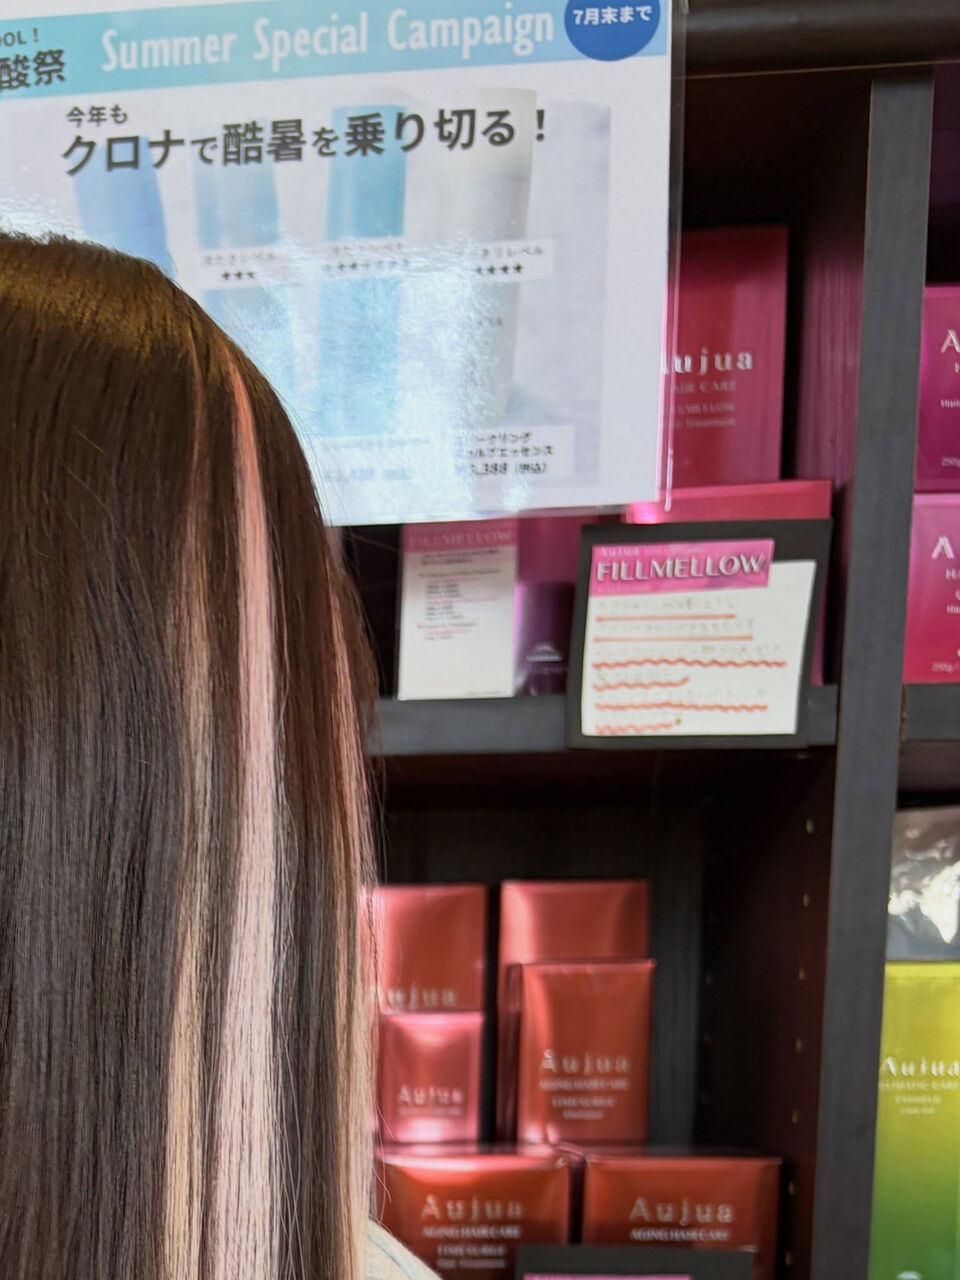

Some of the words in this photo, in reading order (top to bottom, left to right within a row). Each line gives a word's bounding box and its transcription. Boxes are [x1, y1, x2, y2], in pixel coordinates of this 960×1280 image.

[572, 5, 653, 27] 7月末まで
[101, 29, 237, 72] Summer
[253, 12, 368, 73] Special
[387, 2, 555, 59] Campaign
[66, 104, 129, 127] 今年も
[663, 347, 753, 376] ujua
[596, 554, 767, 582] FILLMELLOW
[541, 1049, 631, 1076] Aujua
[421, 1193, 523, 1223] Aujua
[630, 1196, 736, 1226] Aujua
